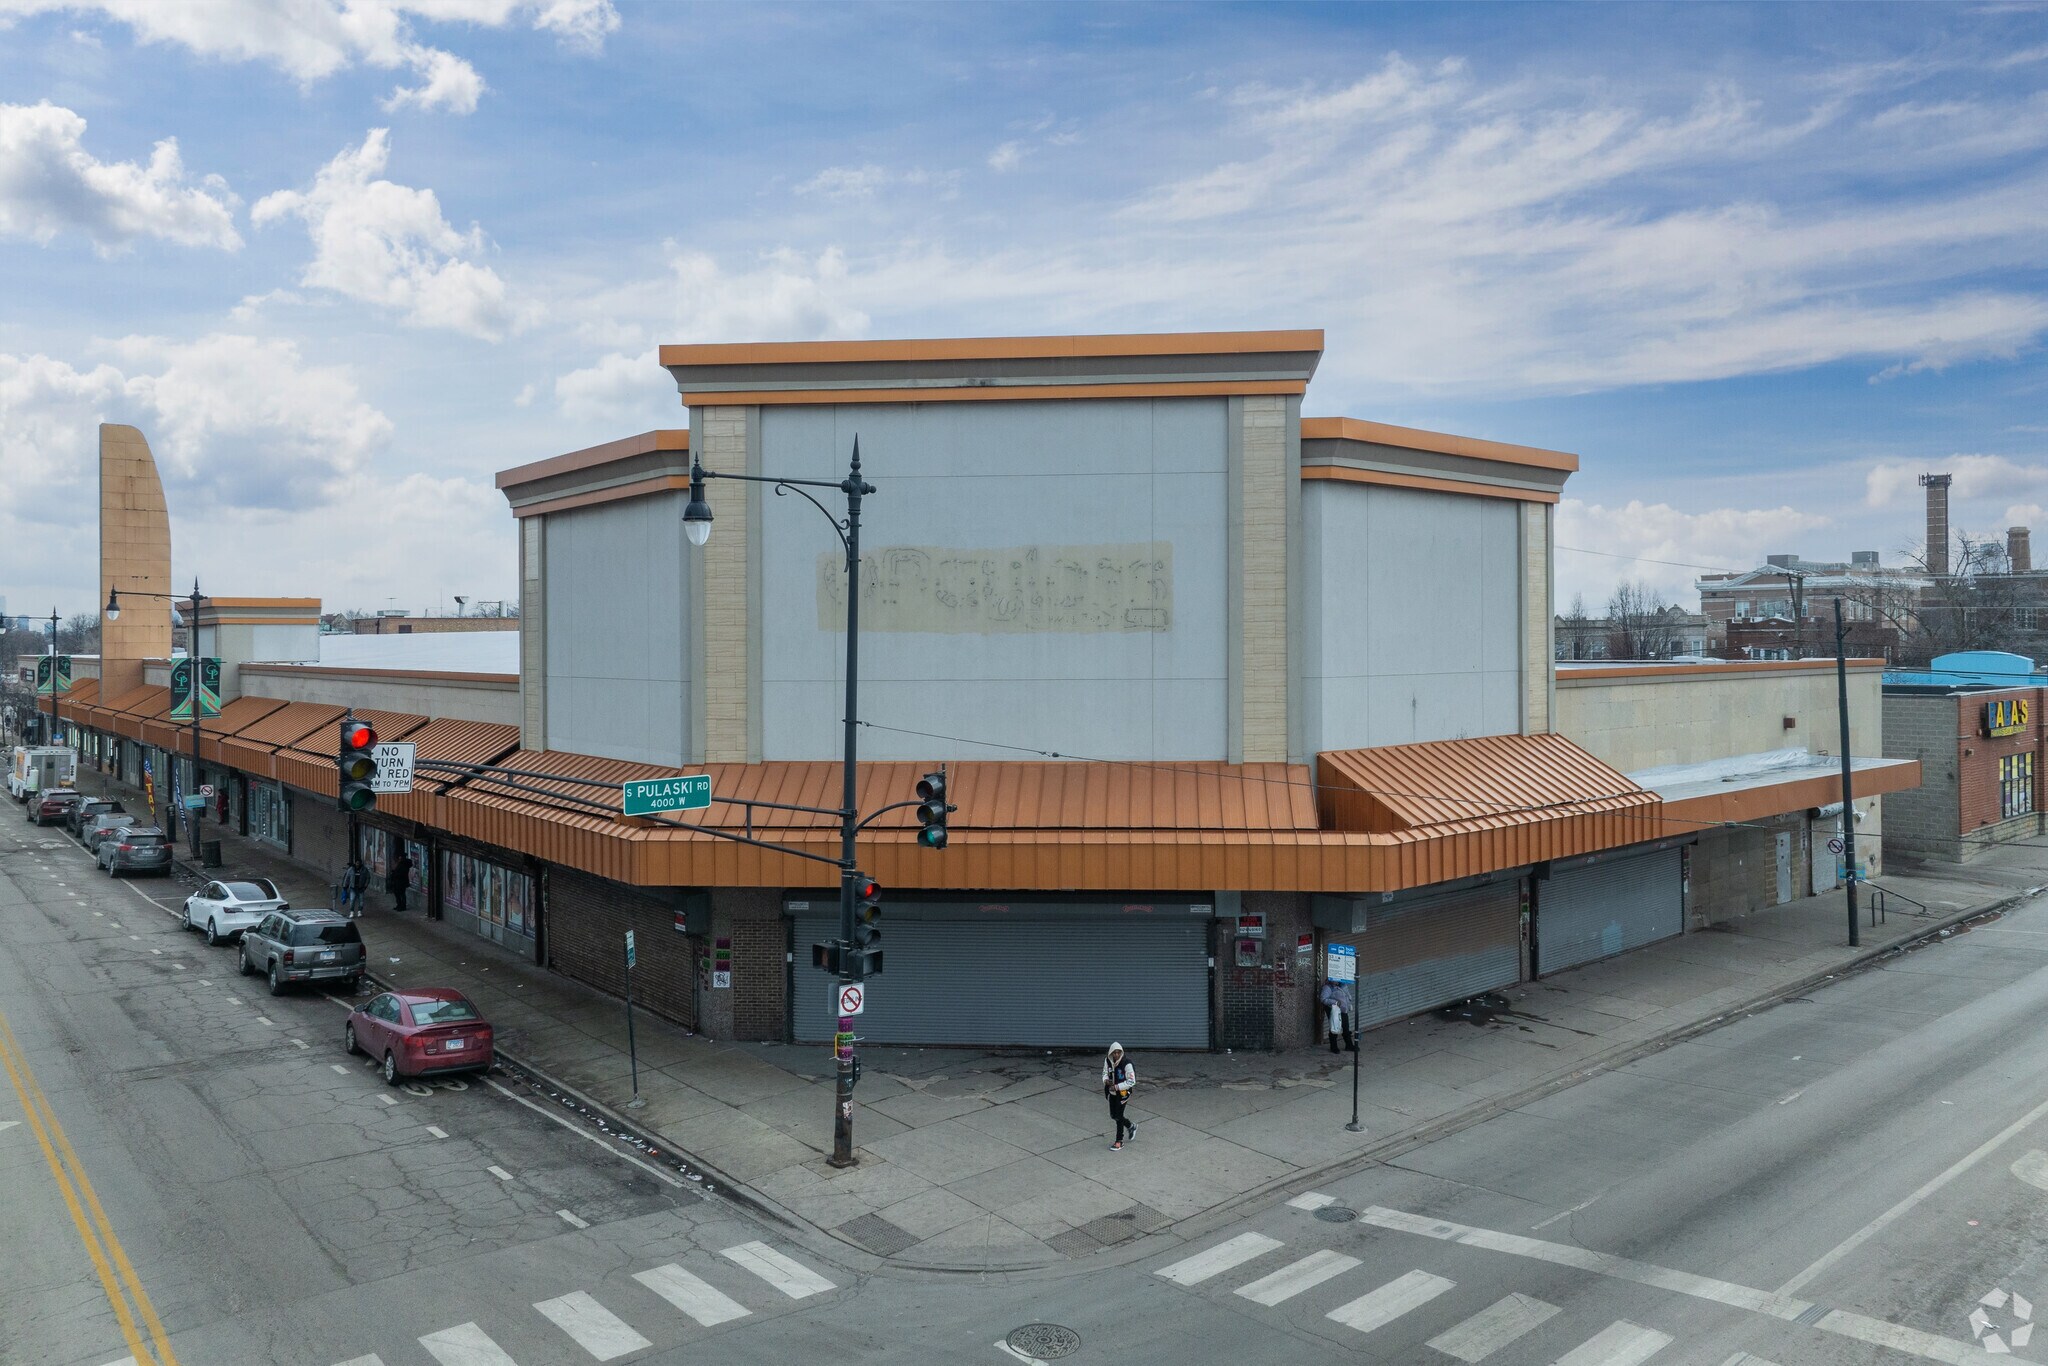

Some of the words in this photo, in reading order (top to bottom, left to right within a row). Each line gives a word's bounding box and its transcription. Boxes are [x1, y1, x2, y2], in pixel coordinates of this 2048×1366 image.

[381, 747, 399, 756] NO
[375, 758, 404, 768] TURN
[387, 769, 410, 779] RED
[626, 788, 633, 798] S
[637, 781, 693, 798] PULASKI
[696, 781, 709, 791] RD
[650, 797, 675, 808] 4000
[678, 796, 686, 806] W
